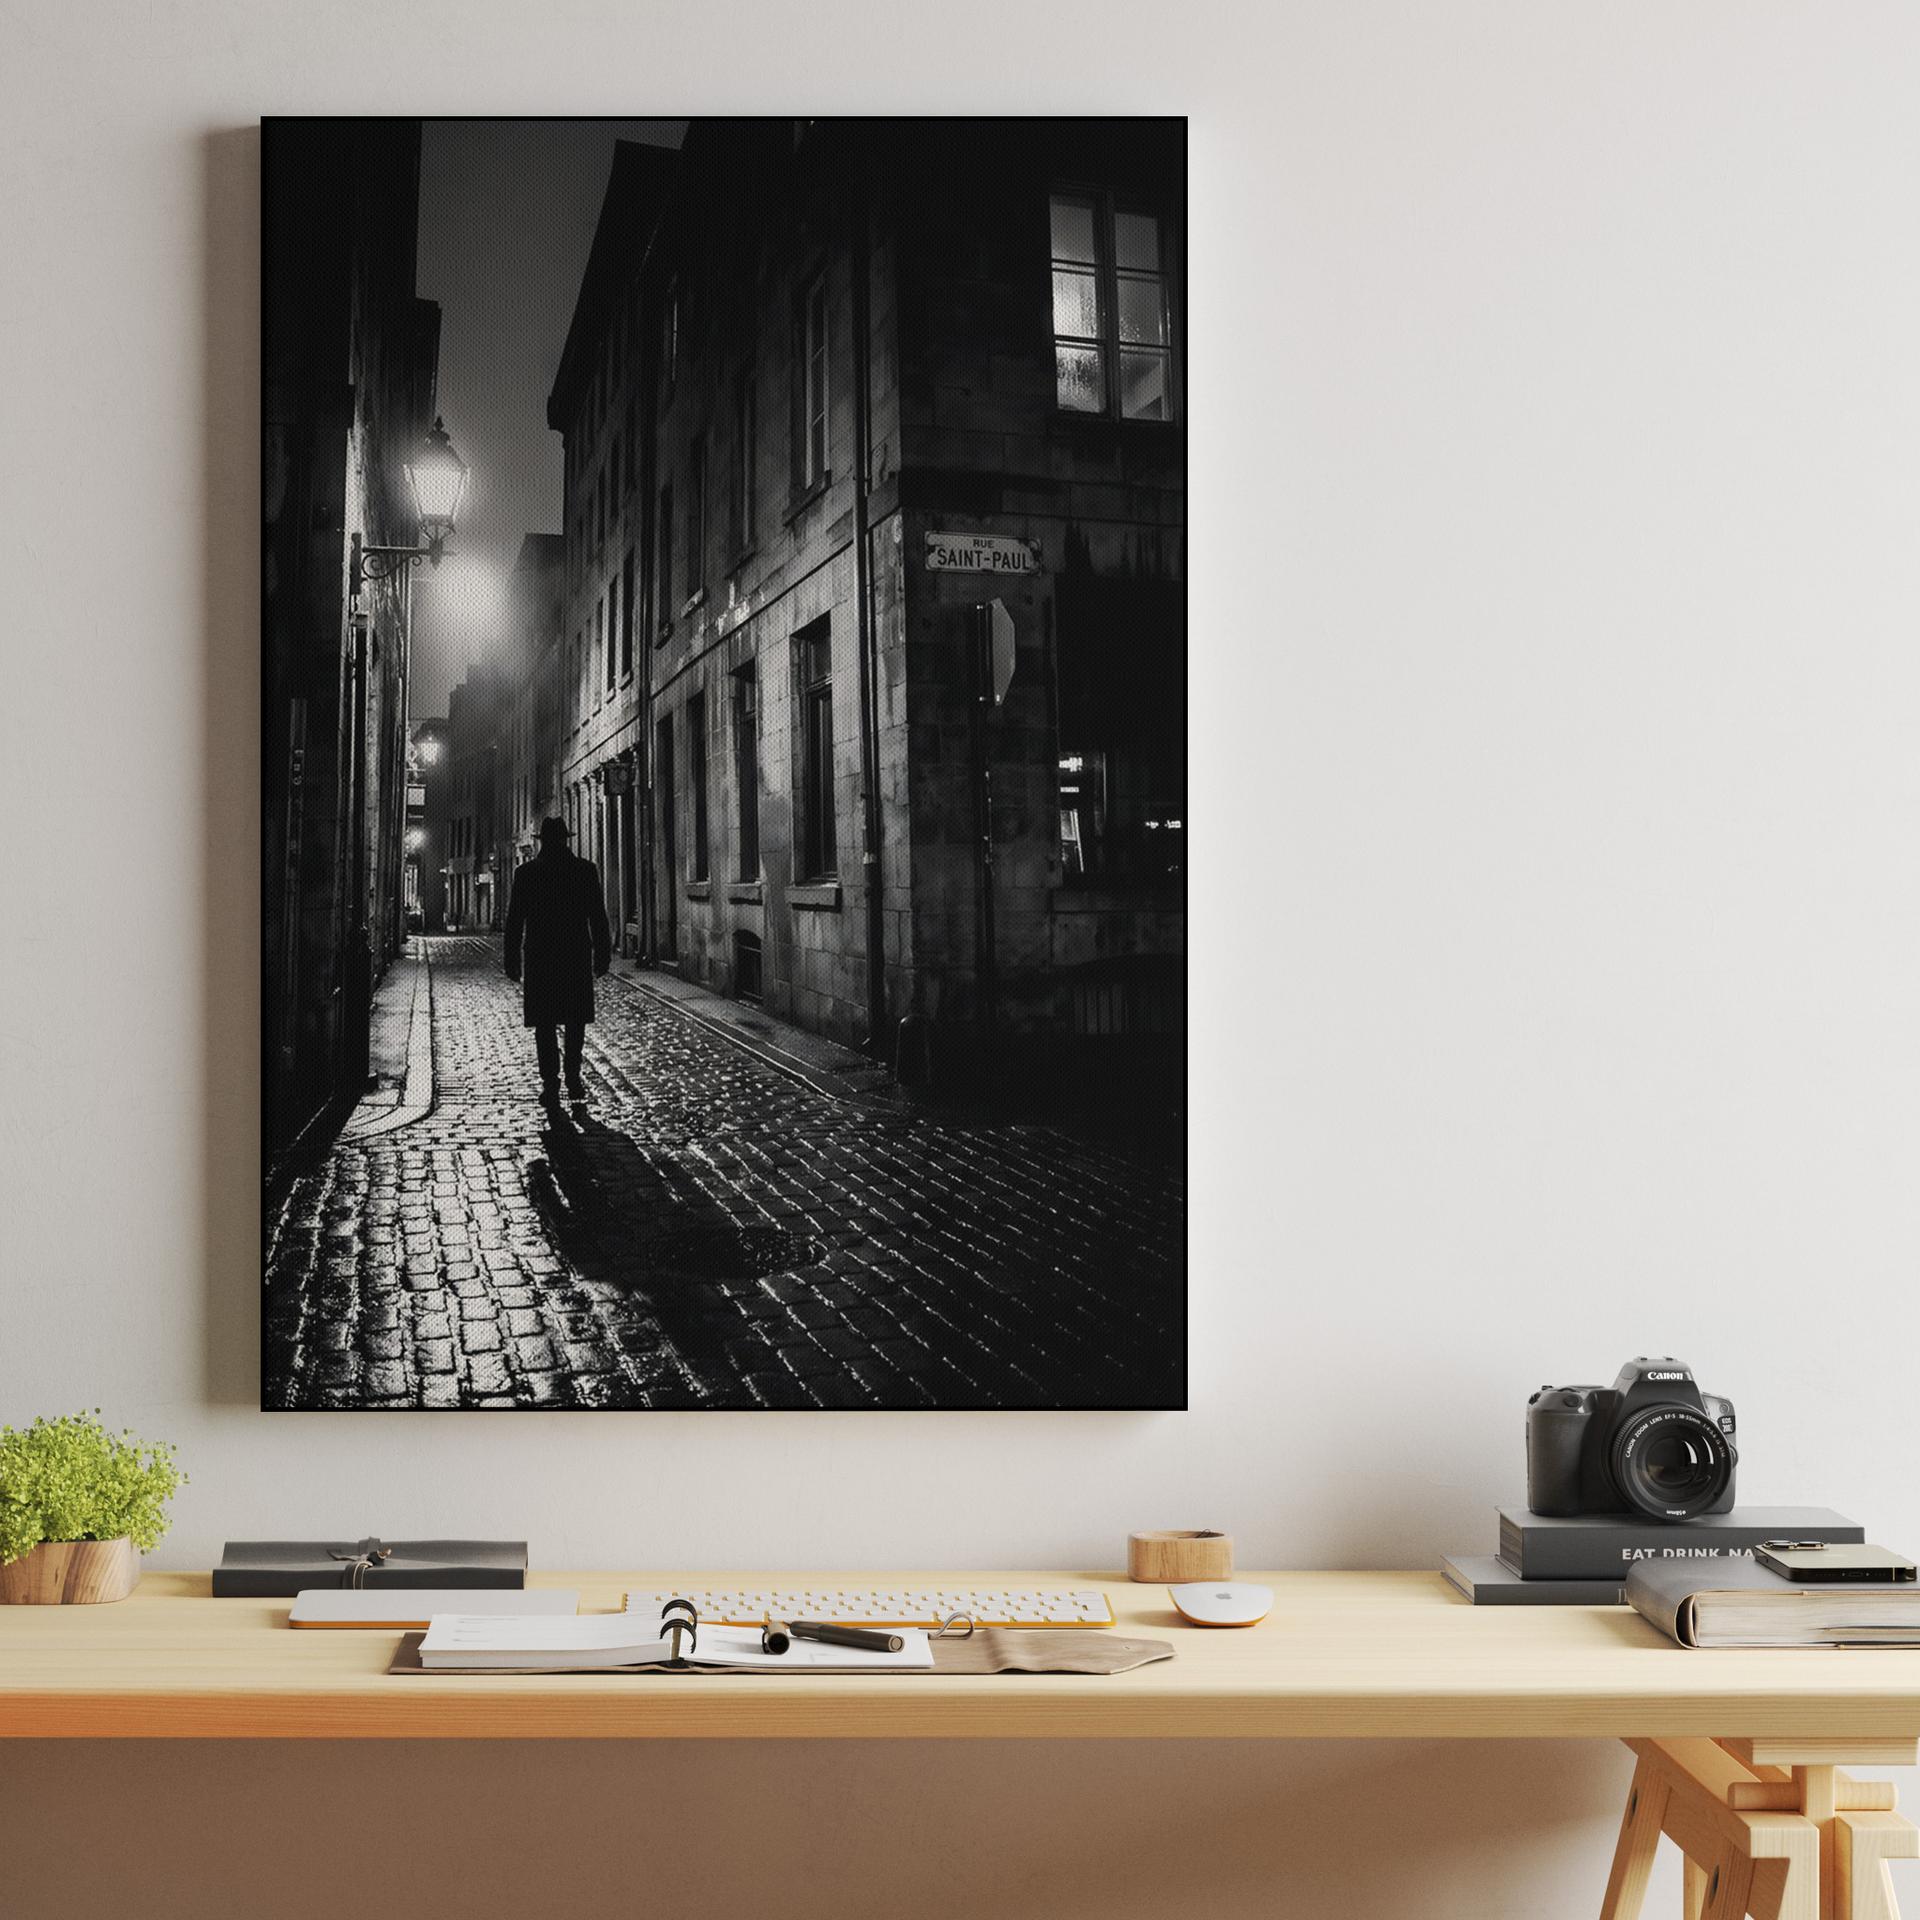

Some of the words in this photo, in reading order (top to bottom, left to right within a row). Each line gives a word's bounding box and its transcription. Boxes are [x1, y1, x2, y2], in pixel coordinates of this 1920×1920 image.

[973, 539, 994, 548] RUE
[937, 548, 1030, 570] SAINT-PAUL
[1647, 1371, 1683, 1380] Canon
[1625, 1438, 1636, 1458] CANON
[1635, 1423, 1649, 1438] ZOOM
[1649, 1416, 1663, 1425] LENS
[1622, 1548, 1656, 1560] EAT
[1663, 1548, 1720, 1557] DRINK
